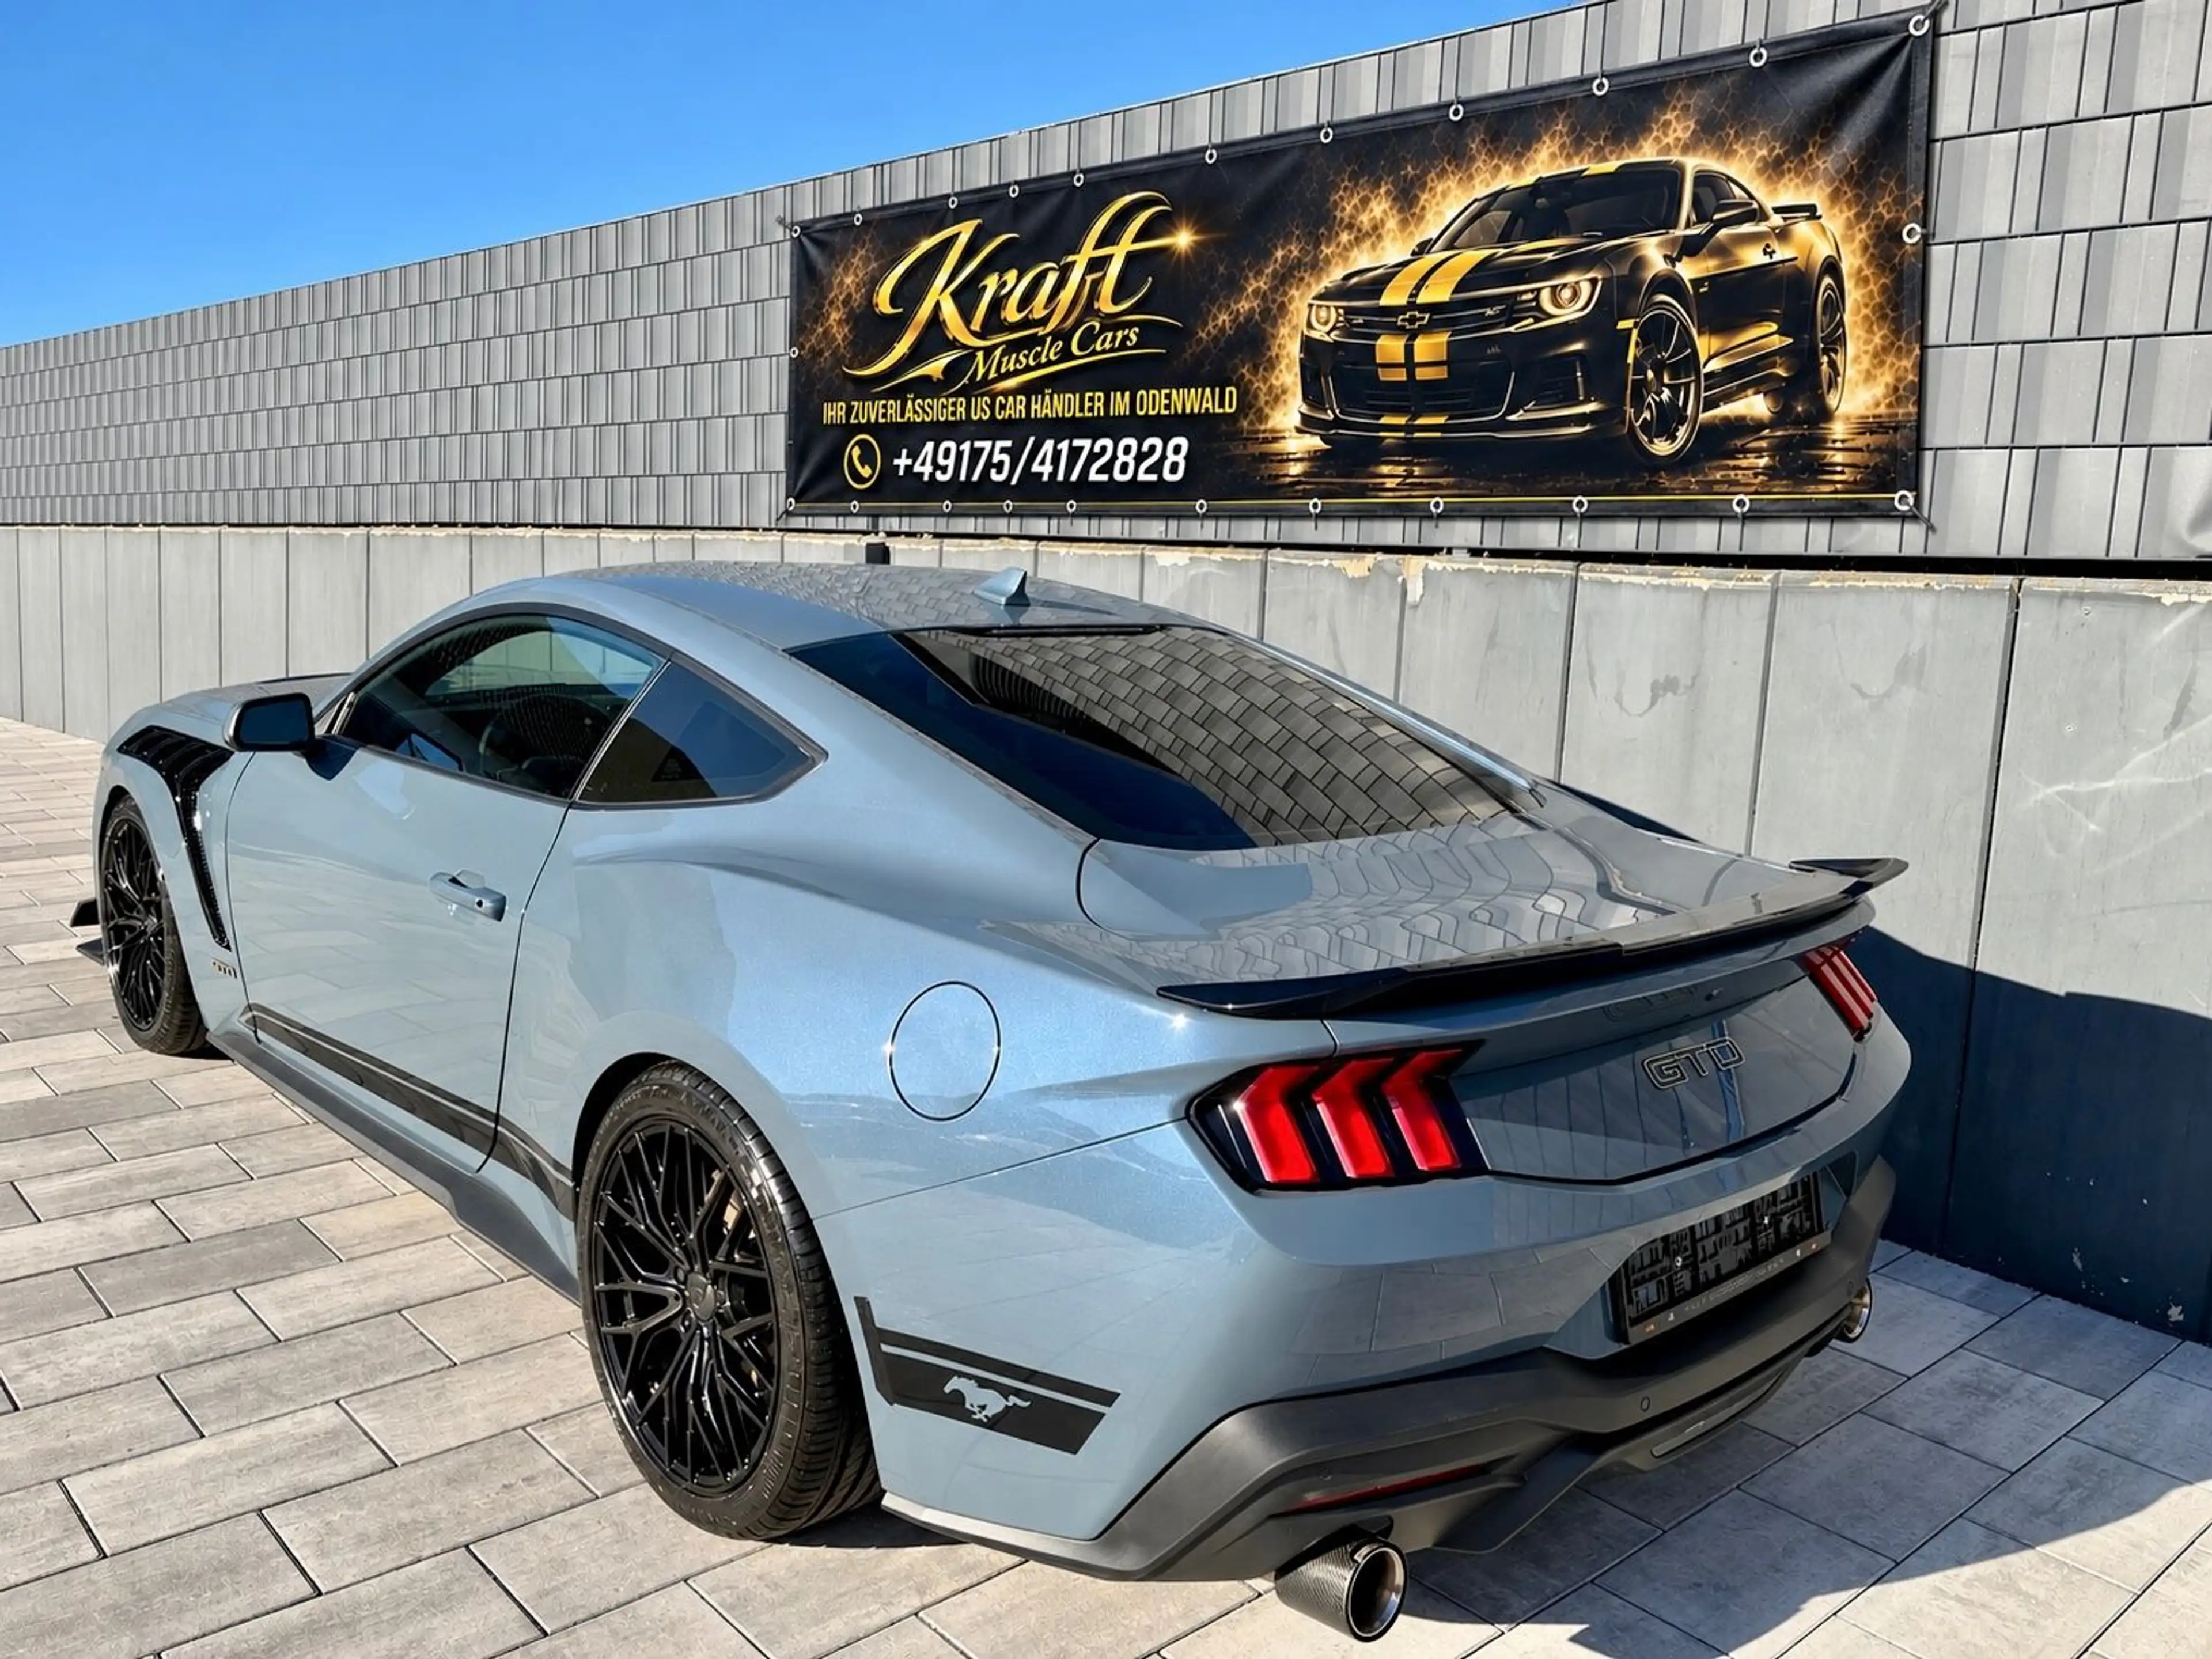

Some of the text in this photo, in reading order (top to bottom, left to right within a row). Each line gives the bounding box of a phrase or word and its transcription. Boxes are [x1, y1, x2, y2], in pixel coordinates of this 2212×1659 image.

[843, 191, 1173, 374] Kraft
[971, 320, 1139, 382] Muscle Cars
[823, 386, 1237, 424] IHR ZUVERLÄSSIGER US CAR HÄNDLER IM ODENWALD
[893, 436, 1189, 486] +49175/4172828
